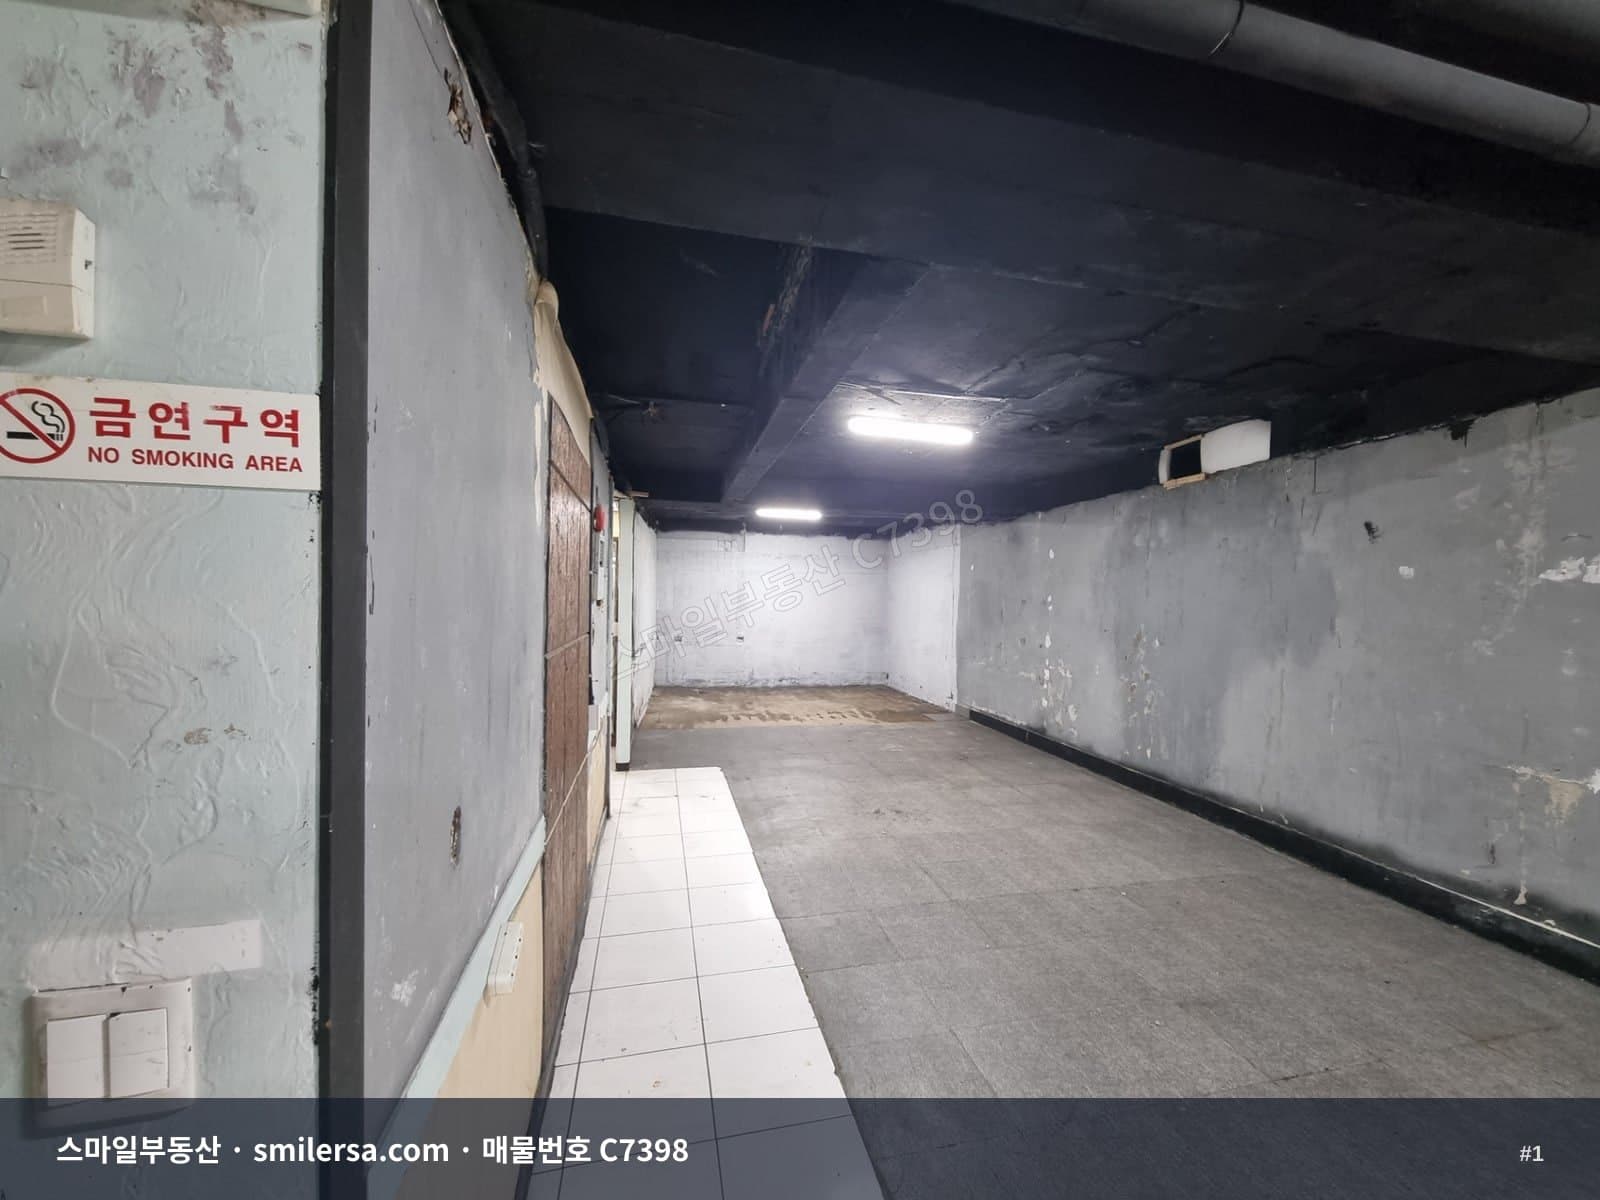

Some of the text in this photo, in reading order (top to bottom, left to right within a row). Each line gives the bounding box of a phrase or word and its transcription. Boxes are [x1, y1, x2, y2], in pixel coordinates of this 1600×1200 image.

[89, 397, 300, 448] 금연구역
[87, 446, 304, 473] NO SMOKING AREA
